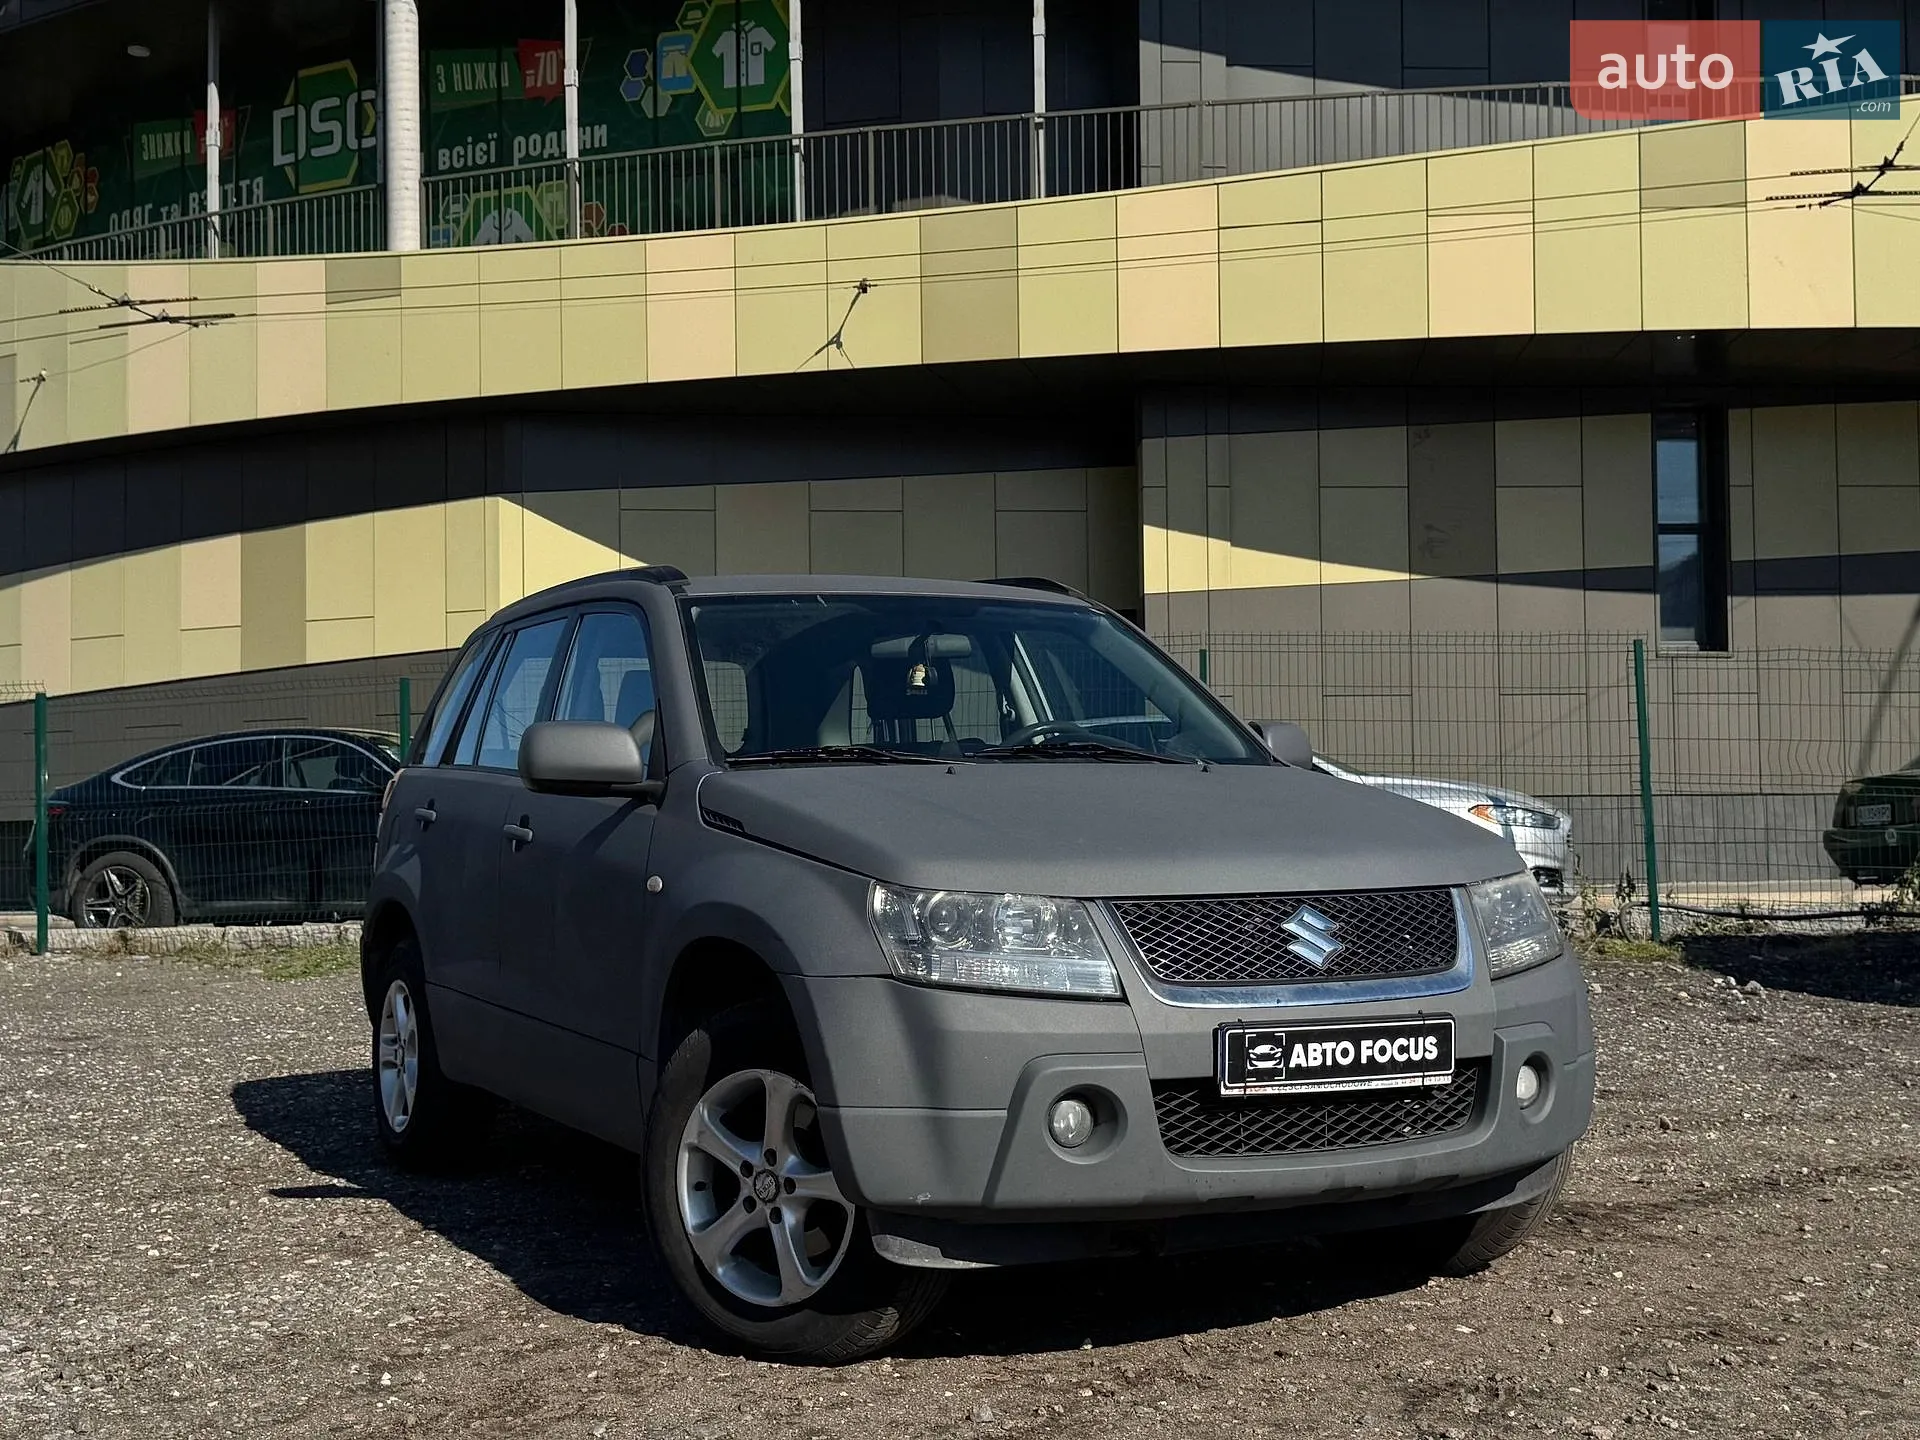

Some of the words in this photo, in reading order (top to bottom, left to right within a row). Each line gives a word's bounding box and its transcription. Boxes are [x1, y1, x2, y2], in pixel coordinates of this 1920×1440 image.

[438, 132, 498, 171] всієї
[1289, 1040, 1355, 1068] АВТО
[1360, 1035, 1439, 1065] FOCUS
